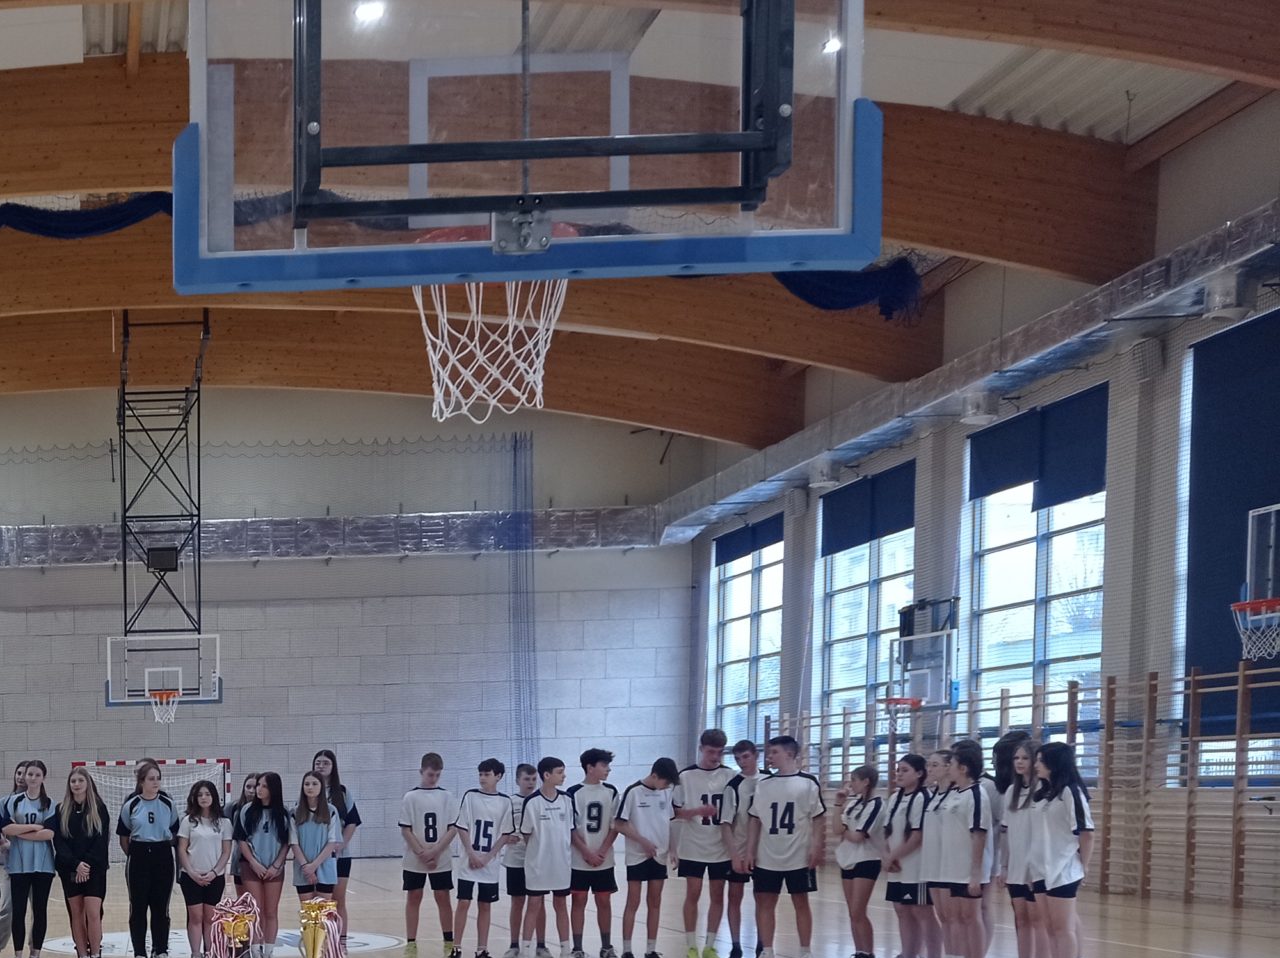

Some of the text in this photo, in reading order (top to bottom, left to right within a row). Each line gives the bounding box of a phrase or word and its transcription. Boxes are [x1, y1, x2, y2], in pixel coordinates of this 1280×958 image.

[24, 812, 37, 824] 10
[148, 811, 156, 824] 6
[586, 802, 603, 833] 9
[701, 793, 724, 825] 10
[769, 801, 795, 835] 14
[262, 820, 270, 833] 4
[424, 812, 438, 843] 8
[472, 819, 494, 853] 15
